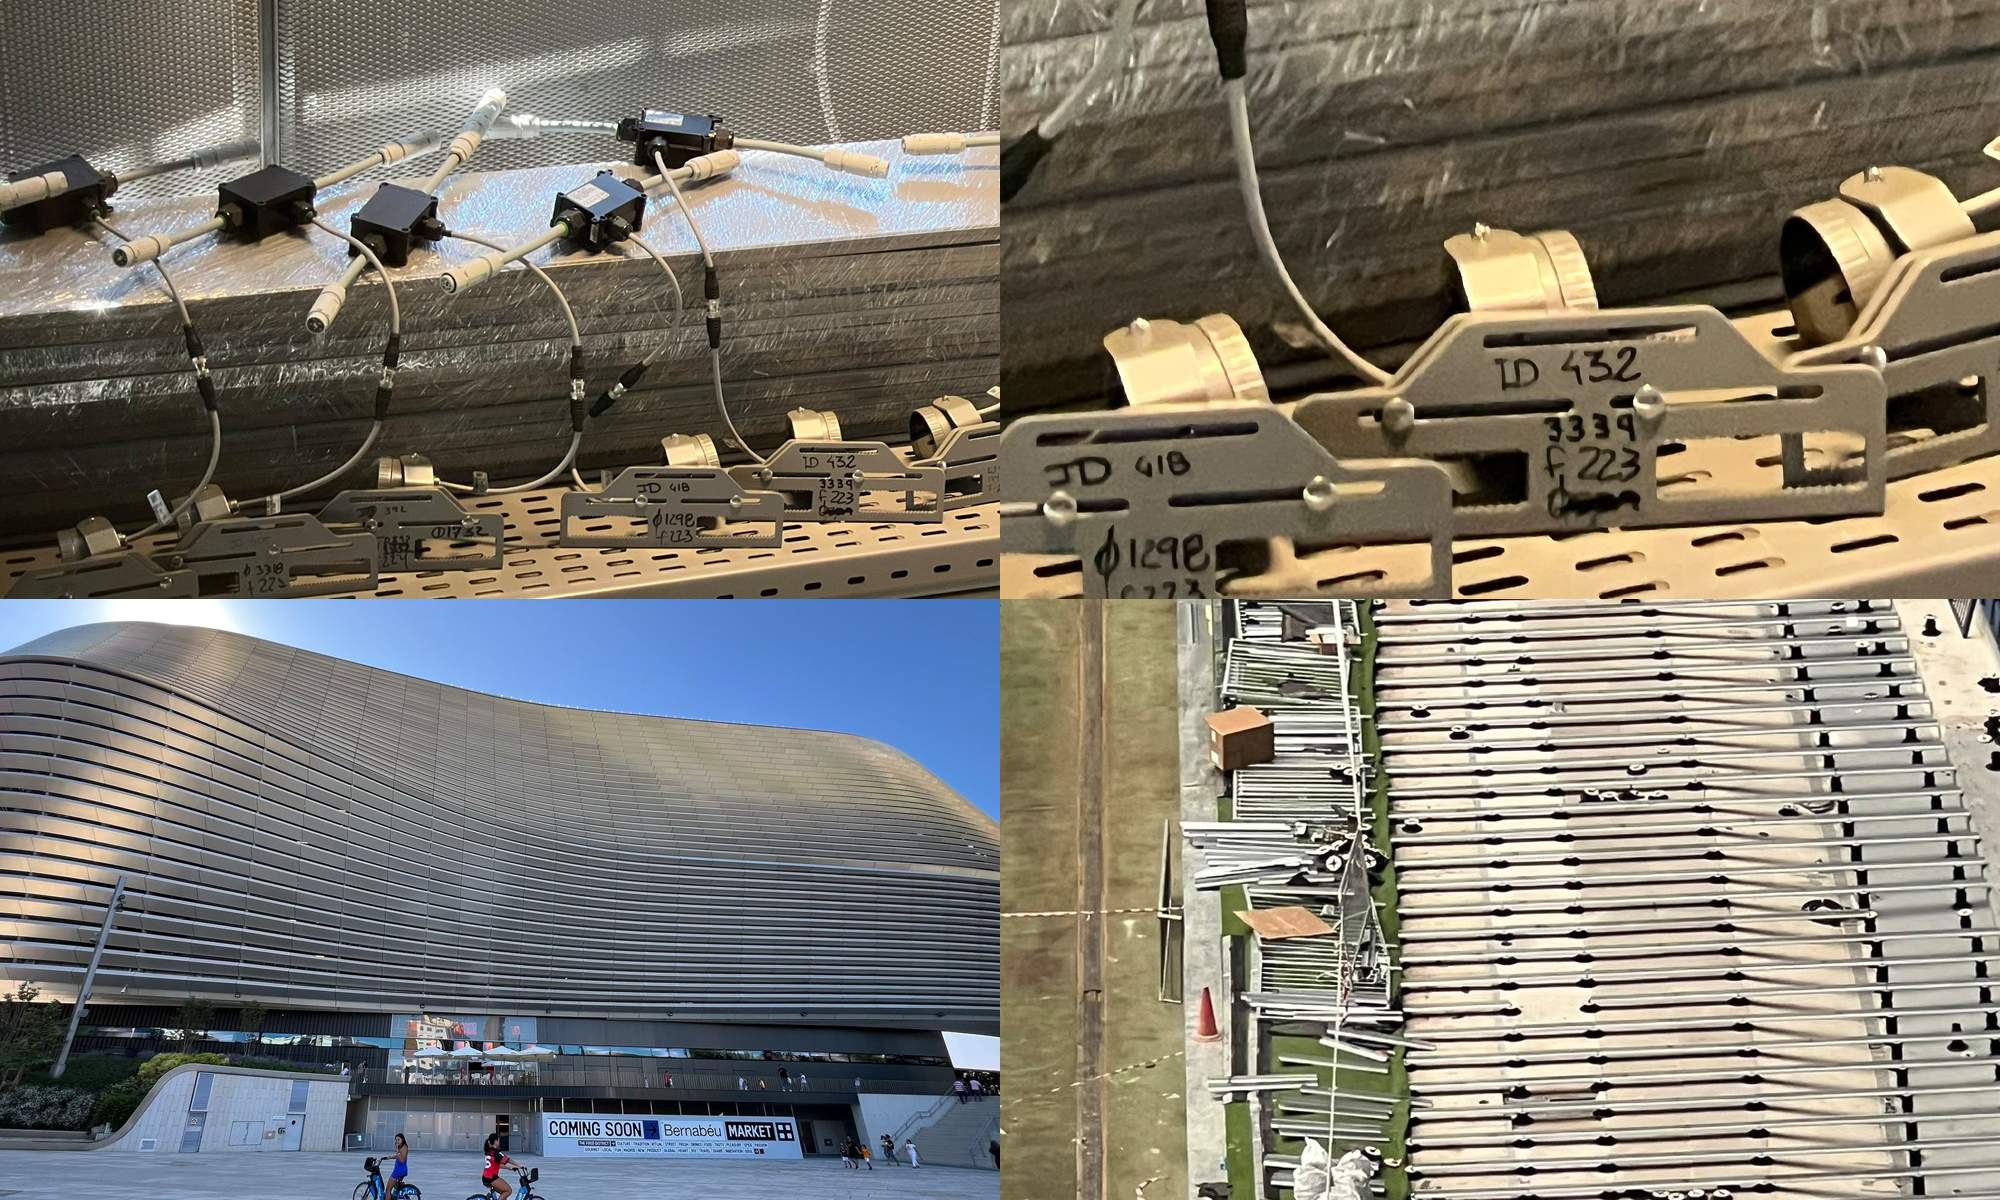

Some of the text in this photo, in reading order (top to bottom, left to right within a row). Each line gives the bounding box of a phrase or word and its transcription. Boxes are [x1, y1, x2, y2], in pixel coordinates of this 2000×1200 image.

[1494, 346, 1641, 391] ID 432
[1543, 413, 1636, 442] 3339
[802, 455, 856, 469] ID 432
[1577, 447, 1640, 481] 223
[819, 479, 853, 490] 3339
[831, 491, 854, 504] 223
[549, 1121, 642, 1137] COMING SOON
[664, 1123, 721, 1137] Bernabéu
[728, 1125, 772, 1138] MARKET
